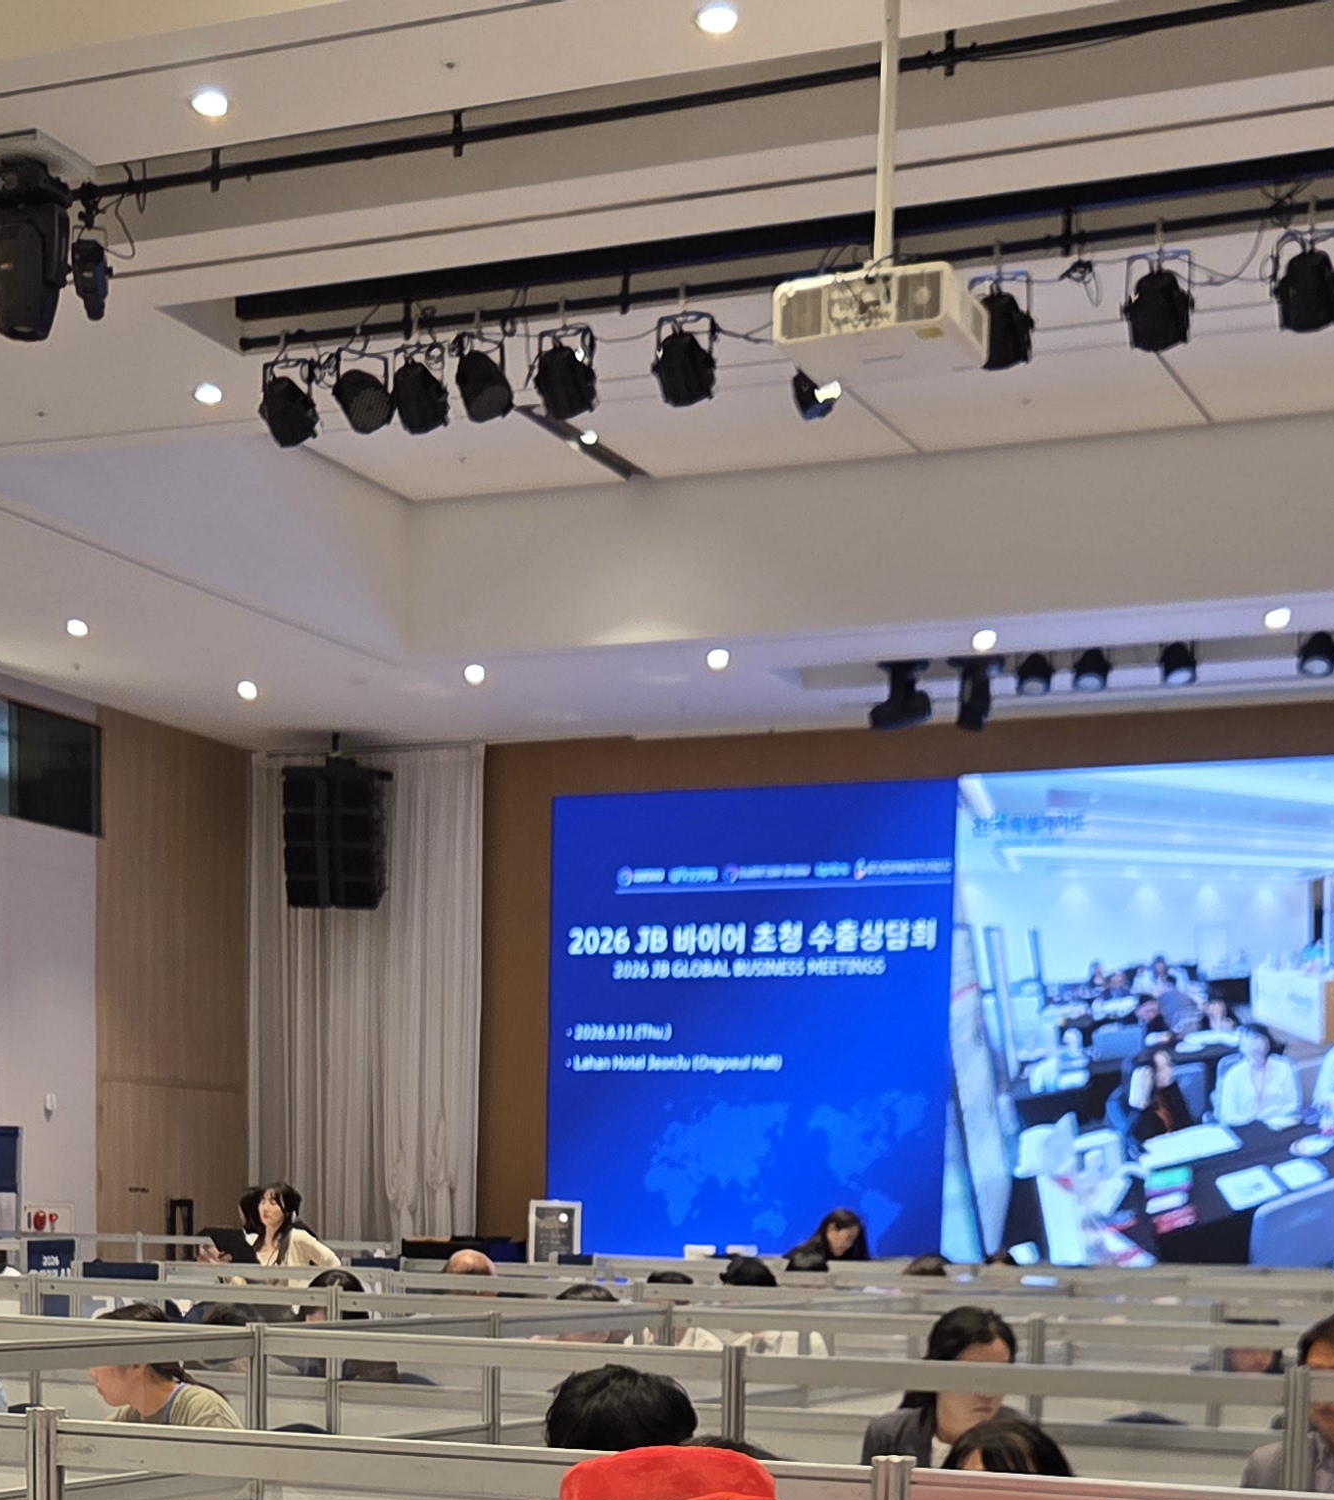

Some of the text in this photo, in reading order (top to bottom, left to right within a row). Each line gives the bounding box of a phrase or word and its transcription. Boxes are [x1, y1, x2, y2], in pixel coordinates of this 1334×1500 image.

[567, 916, 937, 955] 2026 JB 바이어 초청 수출상담회
[613, 955, 886, 980] 2026 JB GLOBAL BUSINESS MEETINGS
